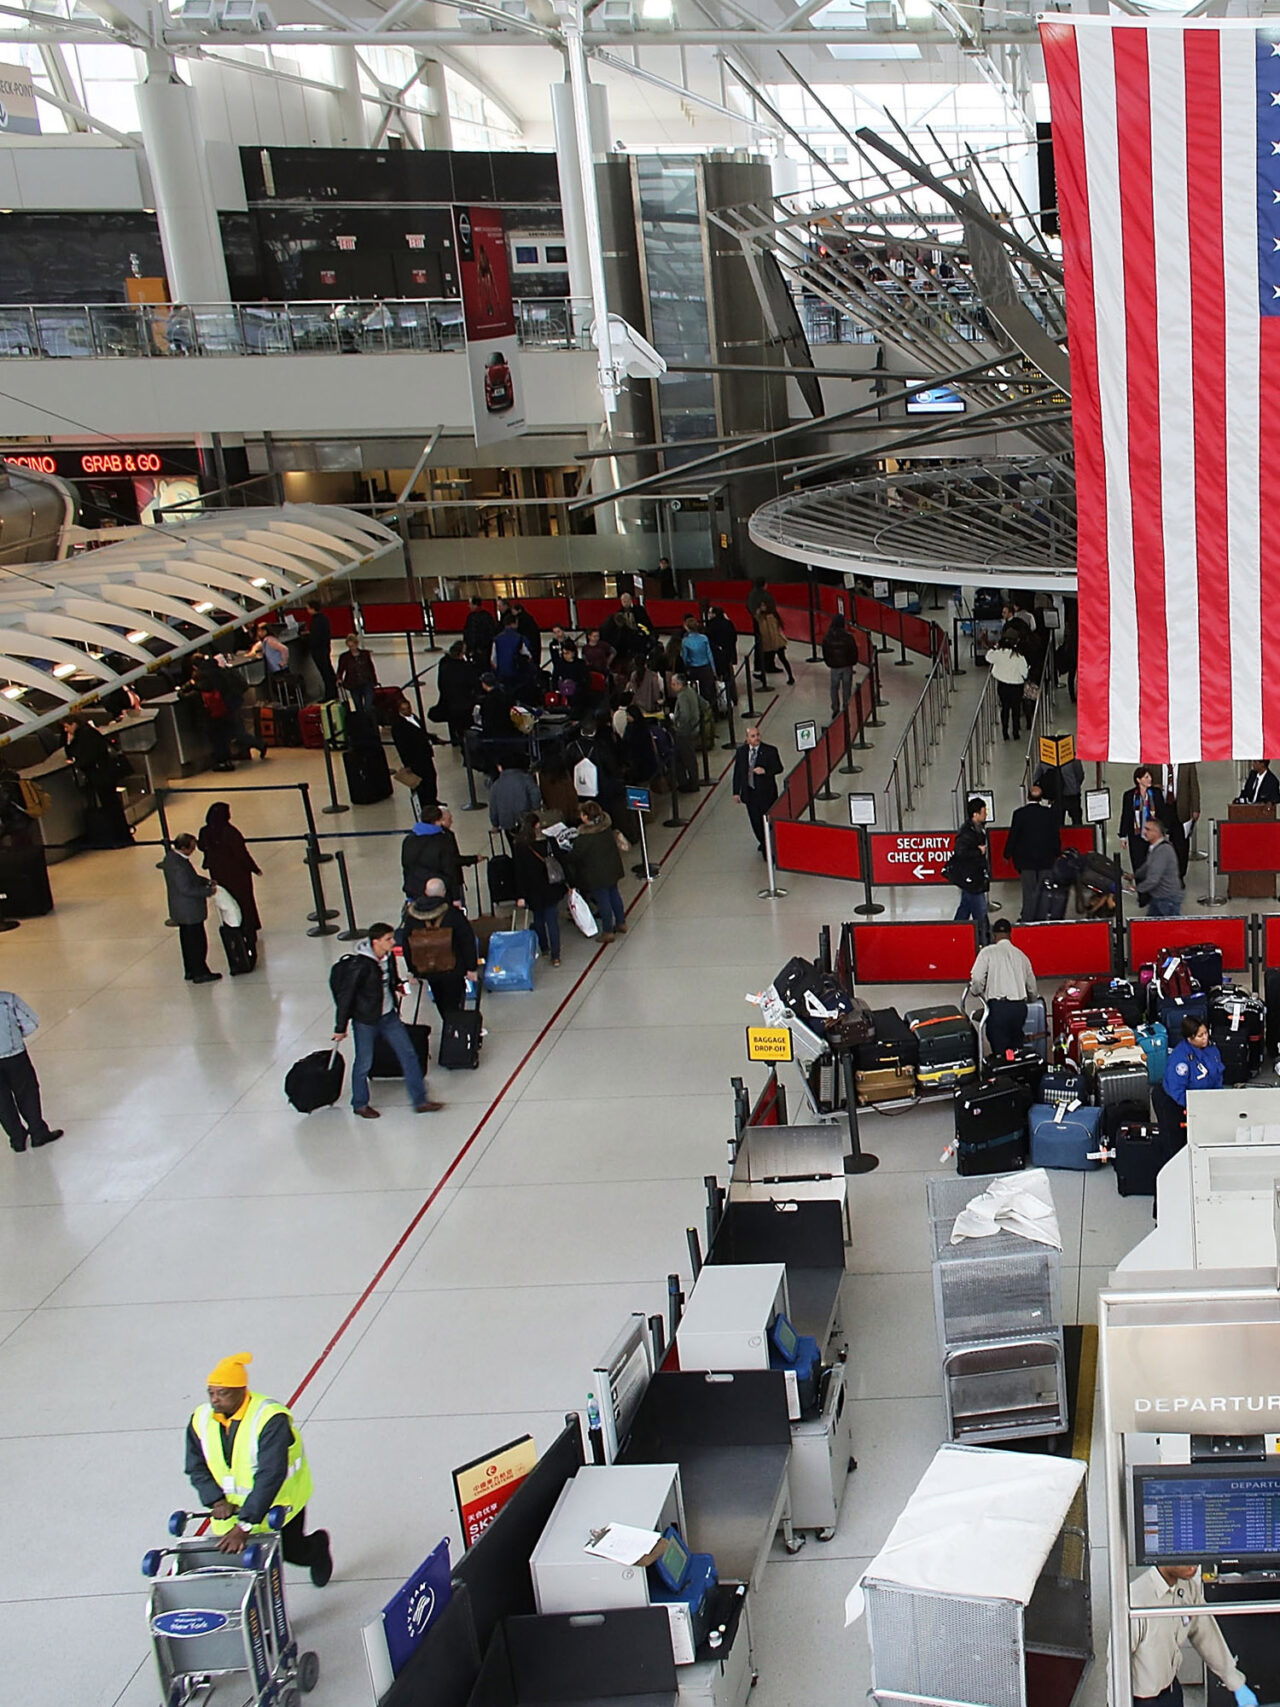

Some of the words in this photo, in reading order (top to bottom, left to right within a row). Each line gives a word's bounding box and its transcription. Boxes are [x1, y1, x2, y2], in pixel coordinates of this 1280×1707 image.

[82, 455, 122, 472] GRAB
[125, 456, 136, 471] &
[137, 454, 160, 471] GO
[896, 837, 950, 849] SECURITY
[887, 851, 925, 863] CHECK
[928, 850, 955, 862] POIN
[753, 1036, 785, 1044] BAGGAGE
